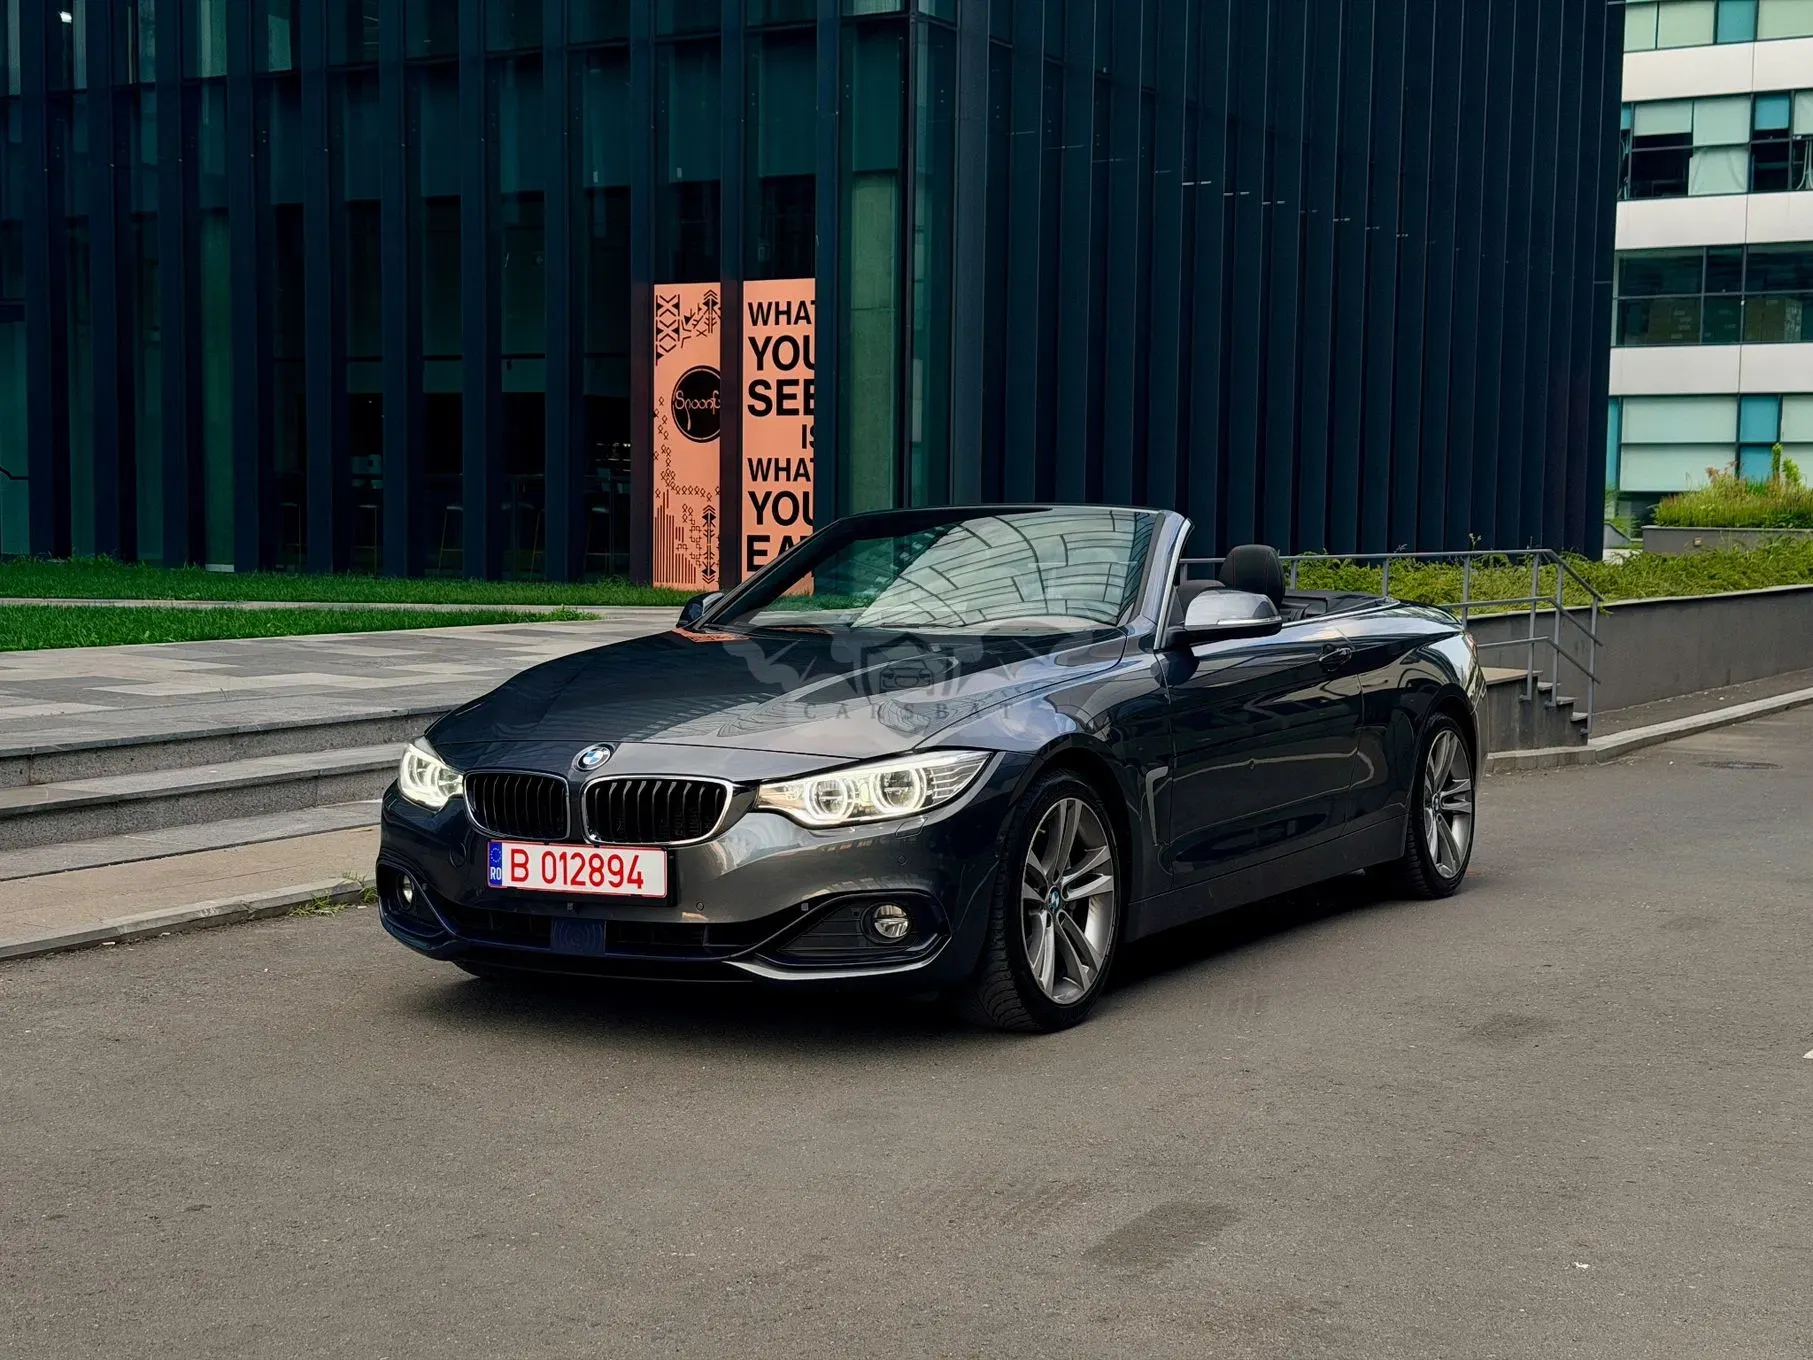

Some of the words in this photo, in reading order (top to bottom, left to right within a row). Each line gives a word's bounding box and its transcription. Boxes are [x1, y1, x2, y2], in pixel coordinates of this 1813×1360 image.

[747, 300, 816, 326] WHA
[747, 457, 815, 482] WHA
[490, 866, 502, 880] RO
[511, 849, 529, 882] B
[541, 851, 644, 889] 012894
